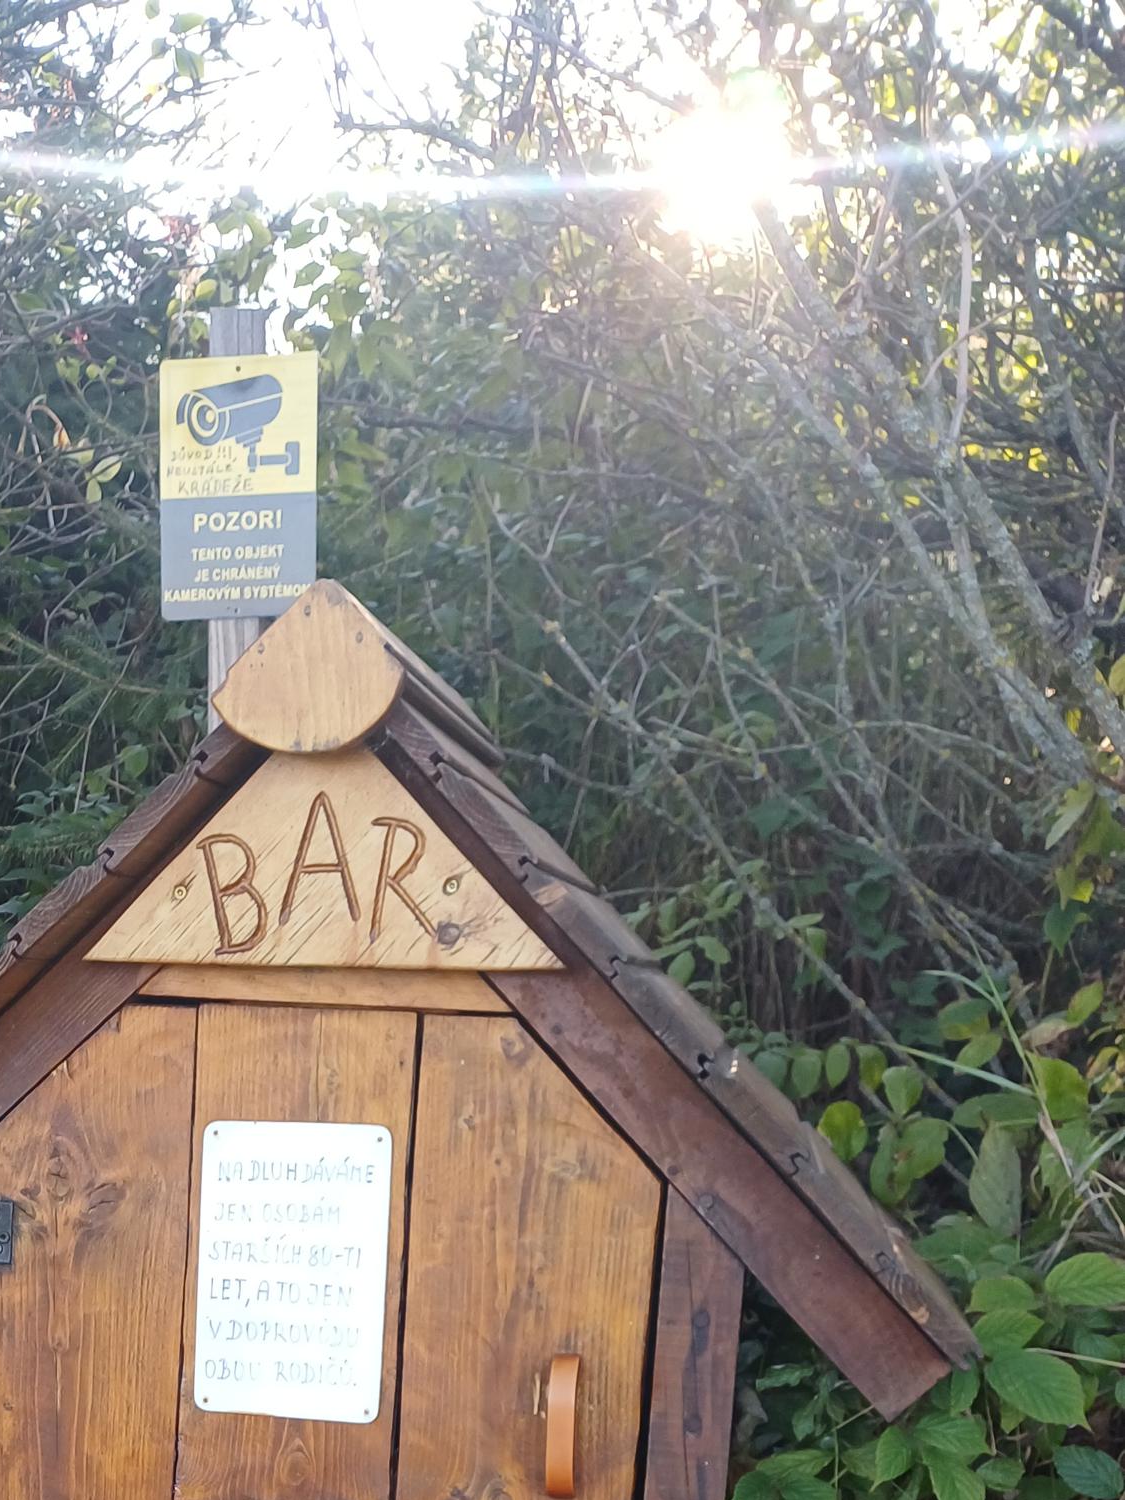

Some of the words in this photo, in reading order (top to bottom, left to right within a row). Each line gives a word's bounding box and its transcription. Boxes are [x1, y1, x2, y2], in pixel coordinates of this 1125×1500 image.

[191, 546, 233, 562] TENTO
[235, 543, 285, 560] OBJEKT
[194, 567, 210, 583] JE
[164, 583, 241, 603] KAMEROVÝM
[195, 790, 439, 956] BAR
[218, 1160, 243, 1183] NA
[248, 1159, 298, 1183] DLUH
[301, 1156, 376, 1184] DÁVÁME
[214, 1202, 252, 1223] JEN
[262, 1196, 341, 1225] OSOBÁM
[210, 1277, 251, 1308] LET,
[256, 1279, 271, 1302] A
[276, 1280, 301, 1304] TO
[306, 1282, 353, 1307] JEN
[208, 1319, 223, 1340] V
